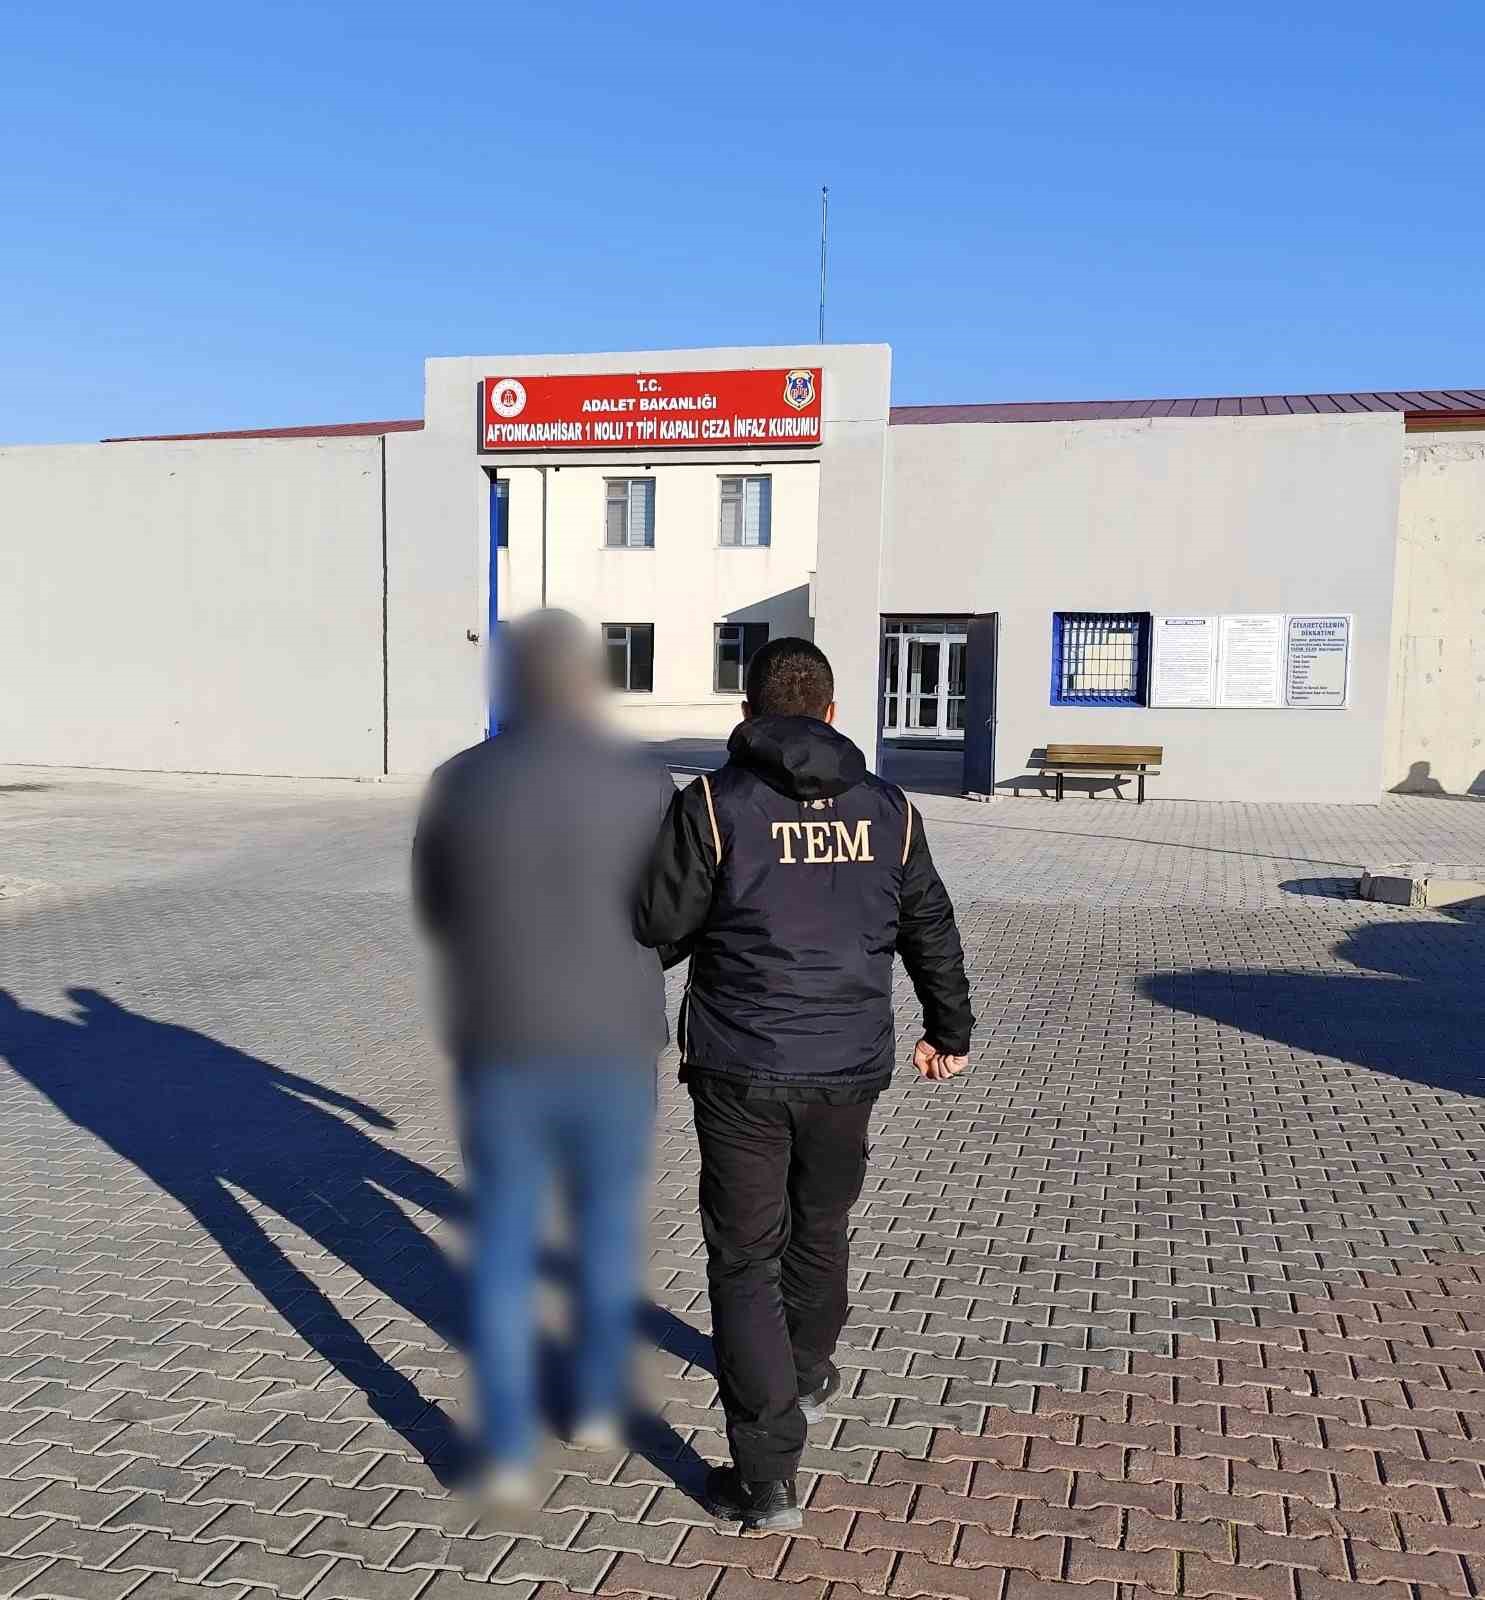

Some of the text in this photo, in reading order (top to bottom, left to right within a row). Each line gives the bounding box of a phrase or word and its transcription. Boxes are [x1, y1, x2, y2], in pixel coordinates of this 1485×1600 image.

[636, 378, 662, 392] T.C.
[581, 394, 717, 412] ADALET BAKANLIĞI
[486, 415, 818, 441] AFYONKARAHİSAR 1 NOLU T TİPİ KAPALI CEZA İNFAZ KURUMU
[771, 820, 875, 864] TEM
